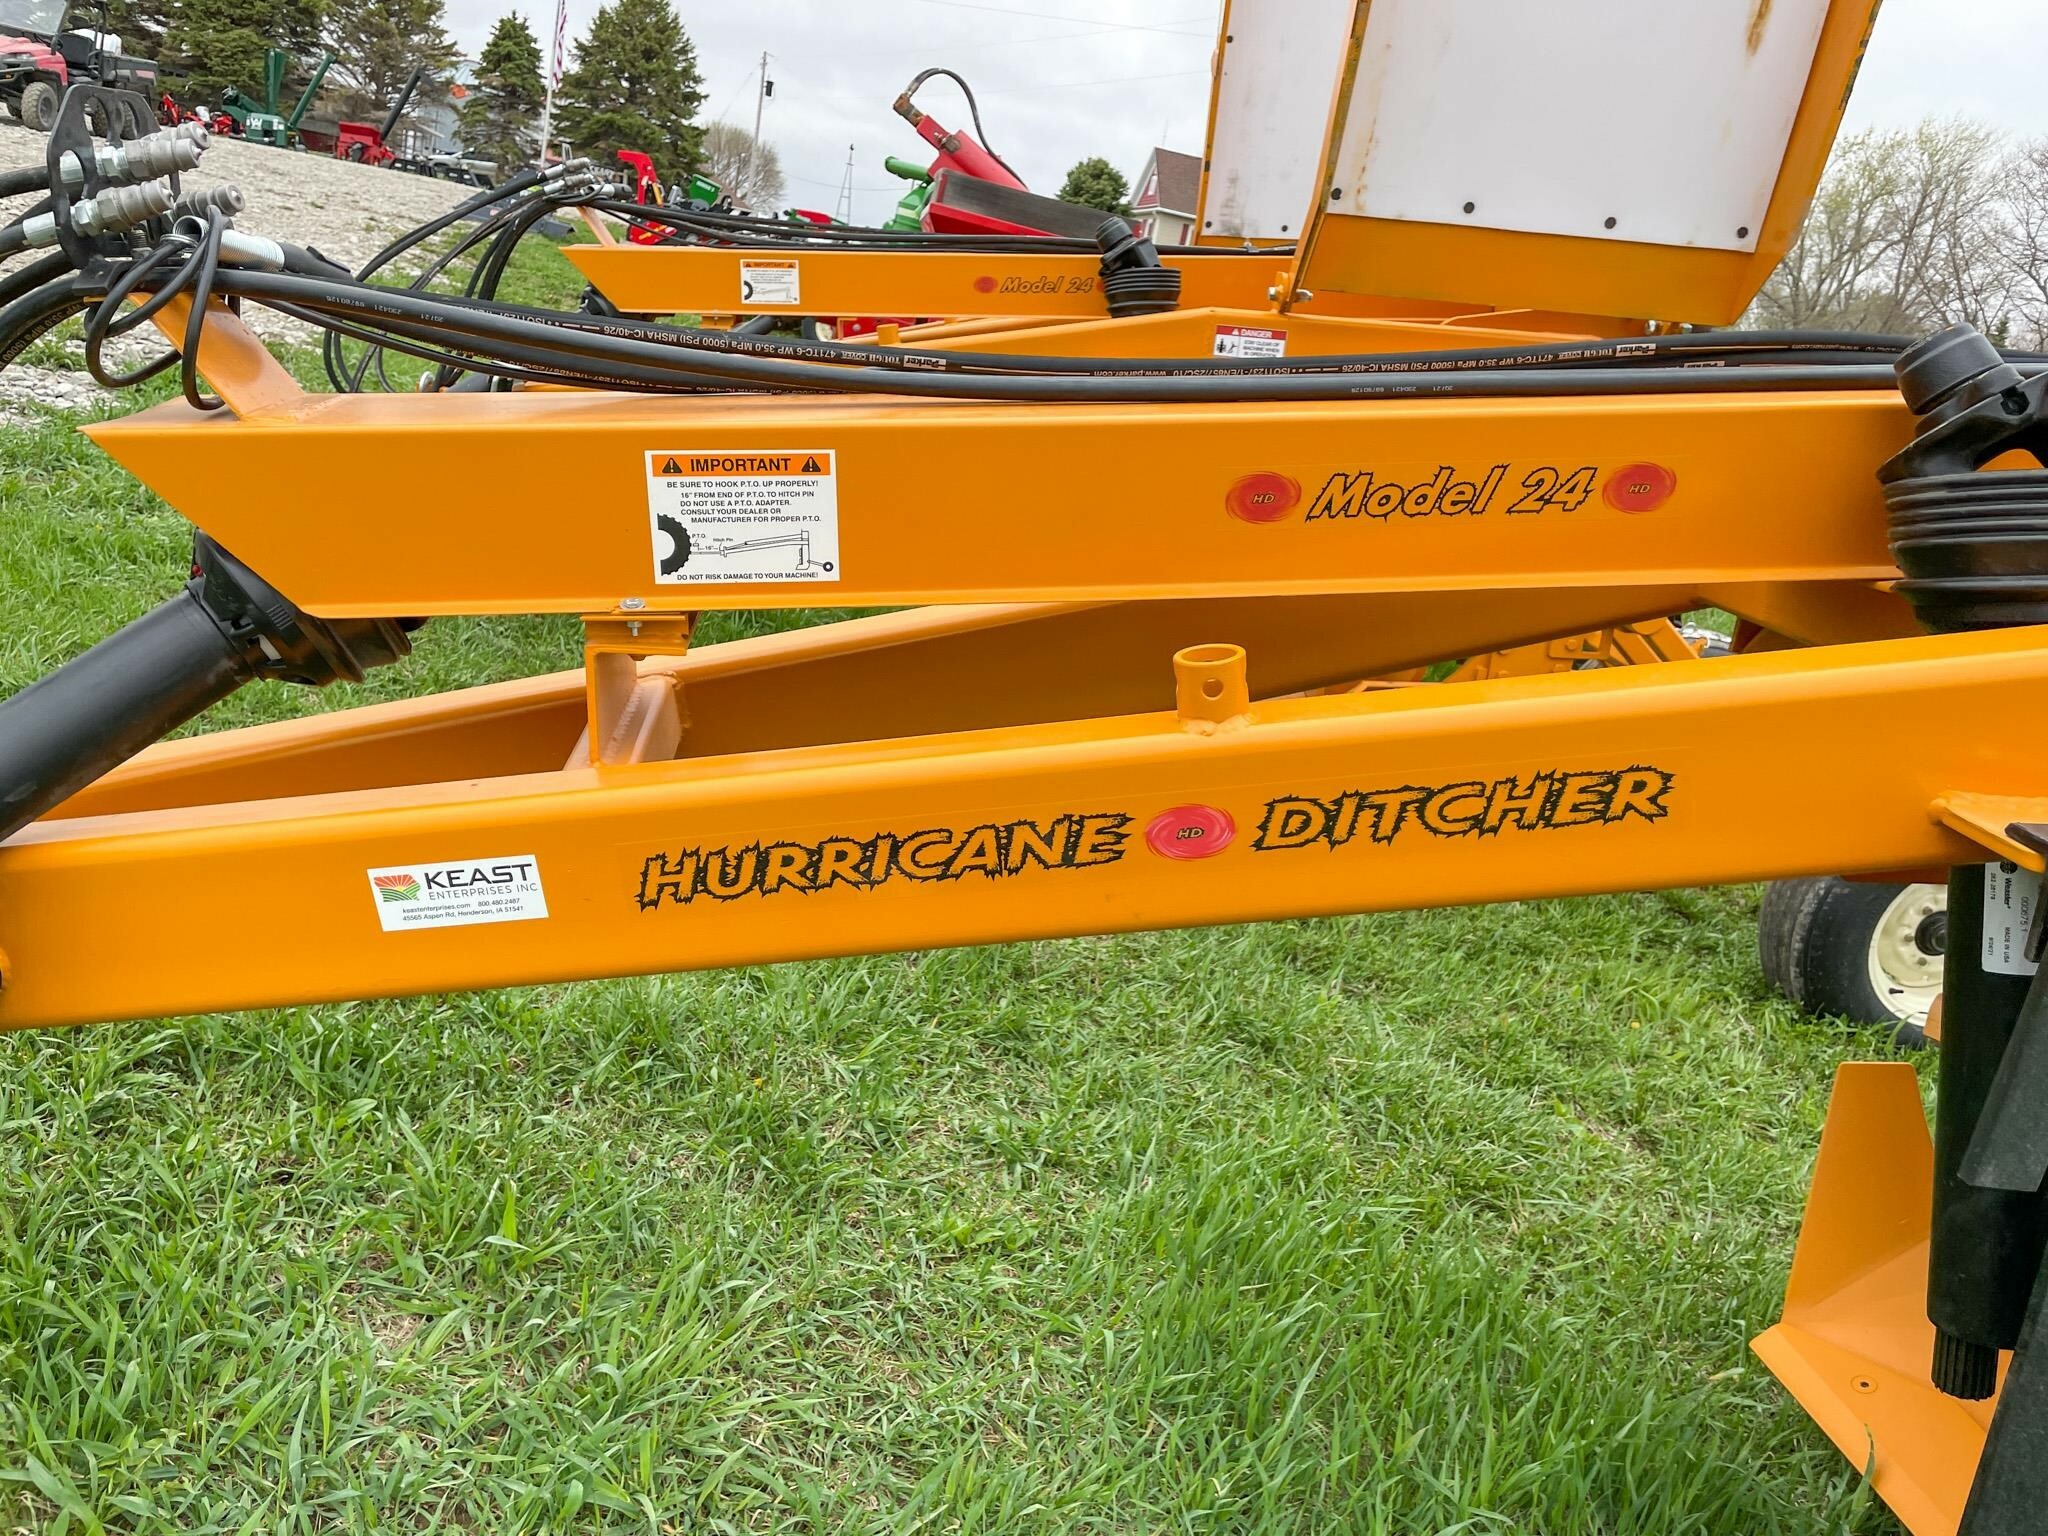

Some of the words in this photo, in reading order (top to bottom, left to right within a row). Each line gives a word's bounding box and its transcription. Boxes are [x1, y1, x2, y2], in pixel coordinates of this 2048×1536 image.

[1000, 276, 1064, 294] Model
[1065, 277, 1095, 294] 24
[603, 326, 644, 338] IC-40/26
[647, 331, 677, 342] MSHA
[1241, 328, 1273, 339] DANGER
[680, 334, 699, 345] PSI)
[702, 337, 728, 348] (5000
[731, 340, 753, 351] MPa
[755, 343, 775, 353] 35.0
[778, 346, 794, 355] WP
[1616, 344, 1656, 356] Parker
[796, 347, 836, 358] 471TC-6
[904, 357, 946, 370] Parker
[1457, 359, 1477, 369] MPa
[1479, 358, 1498, 367] 35.0
[1499, 357, 1515, 366] WP
[1517, 354, 1554, 365] 471TC-6
[1342, 364, 1379, 373] IC-40/26
[1381, 363, 1409, 372] MSHA
[1411, 362, 1429, 371] PSI)
[1430, 360, 1455, 371] (5000
[1094, 369, 1167, 377] www.parker.com
[690, 458, 791, 472] IMPORTANT
[715, 480, 739, 488] HOOK
[740, 480, 761, 488] P.T.O.
[775, 480, 819, 488] PROPERLY!
[1628, 484, 1651, 495] HD
[1304, 462, 1510, 523] Model
[1506, 466, 1599, 515] 24
[1252, 493, 1276, 505] HD
[680, 508, 715, 516] CONSULT
[691, 516, 752, 524] MANUFACTURER
[1250, 764, 1676, 852] DITCHER
[1175, 825, 1206, 841] HD
[633, 812, 1137, 912] HURRICANE
[424, 863, 532, 890] KEAST
[428, 885, 512, 901] ENTERPRISES
[516, 882, 538, 893] INC
[402, 902, 471, 914] keastenterprises.com
[423, 912, 444, 921] Aspen
[444, 911, 456, 919] Rd,
[457, 908, 495, 917] Henderson,
[504, 905, 524, 913] 51541
[2003, 951, 2011, 963] USA
